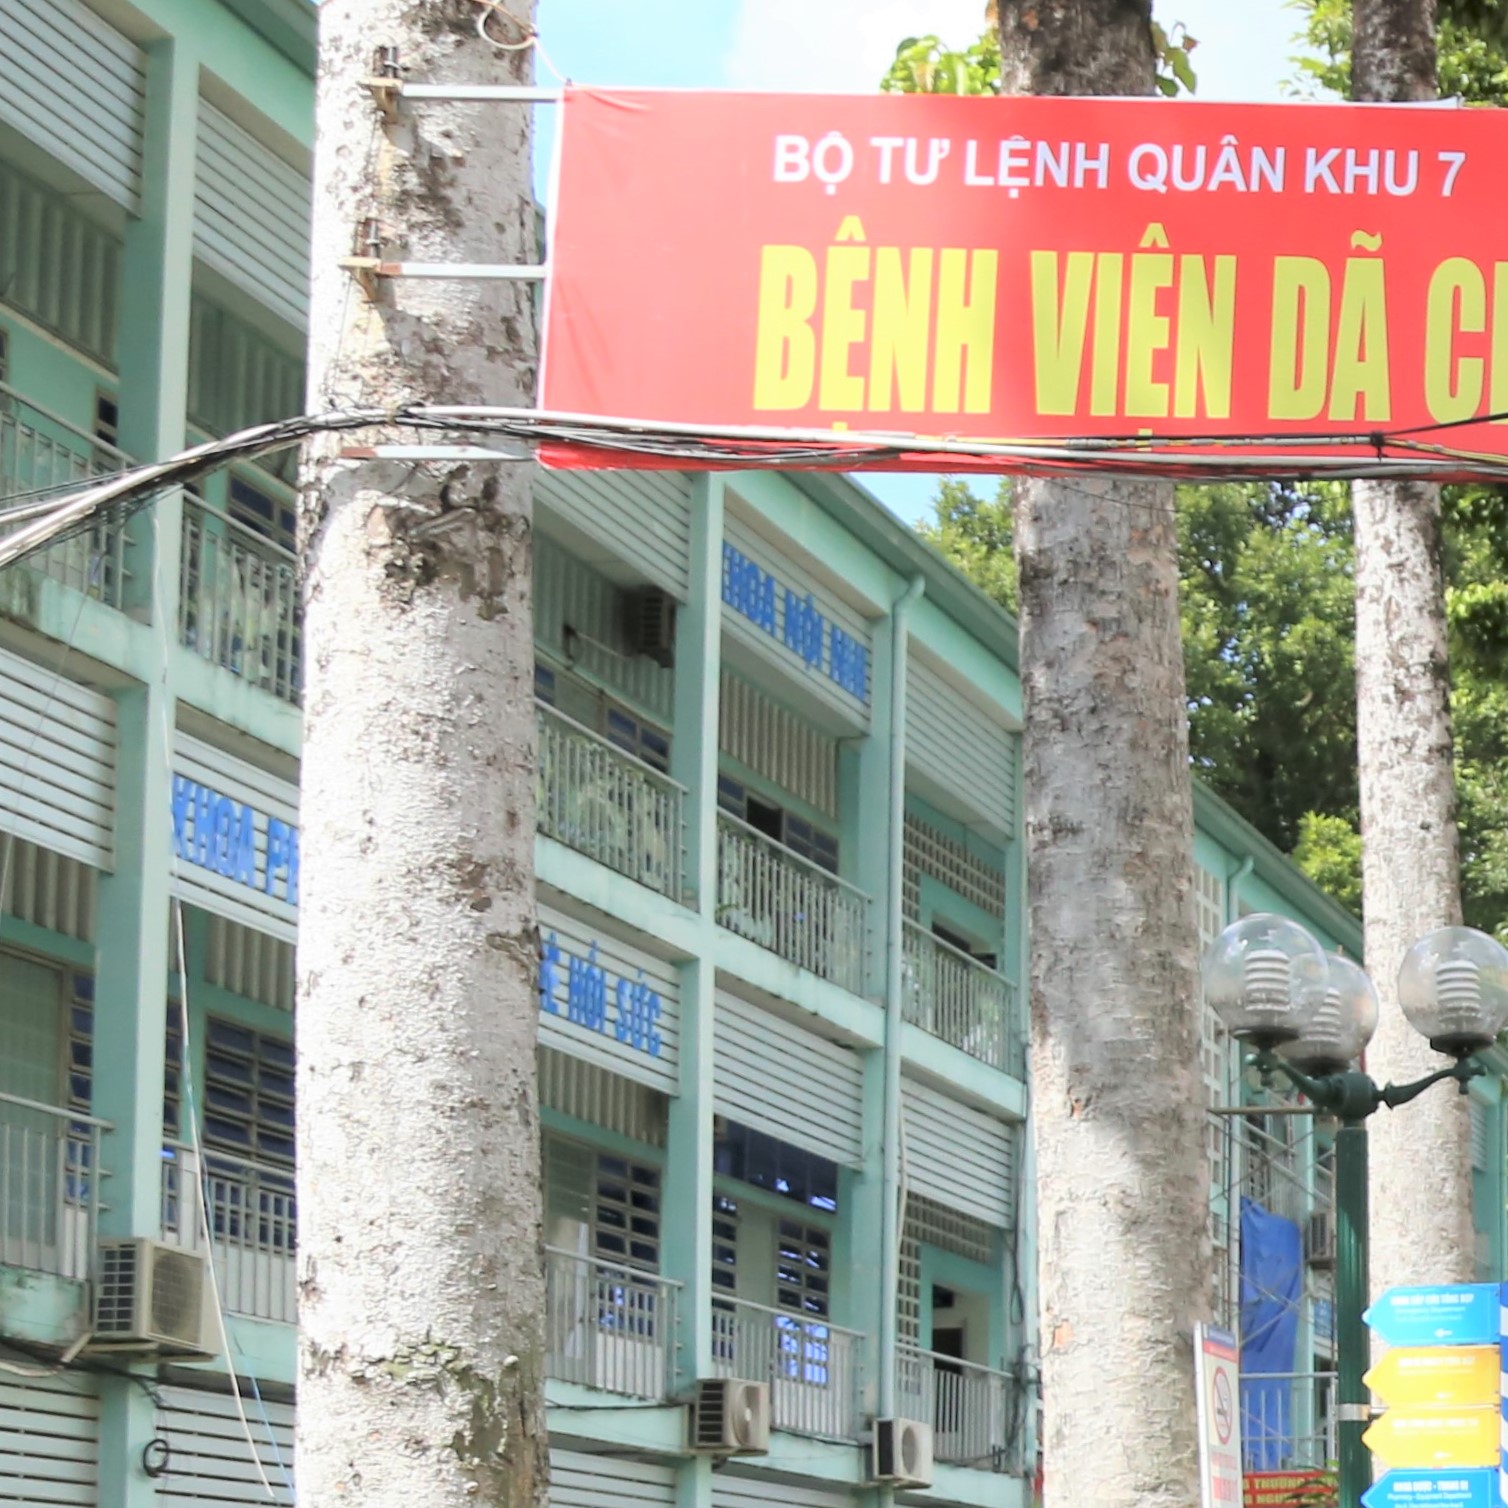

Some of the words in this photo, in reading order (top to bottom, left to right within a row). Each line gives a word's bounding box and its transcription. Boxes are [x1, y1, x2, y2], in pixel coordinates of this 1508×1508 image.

[773, 132, 854, 196] BỘ
[870, 136, 950, 187] TƯ
[964, 133, 1109, 199] LỆNH
[1127, 130, 1286, 196] QUÂN
[1304, 147, 1420, 197] KHU
[1438, 152, 1465, 197] 7
[754, 216, 998, 431] BỆNH
[1030, 223, 1237, 450] VIỆN
[1267, 231, 1394, 425] DÃ
